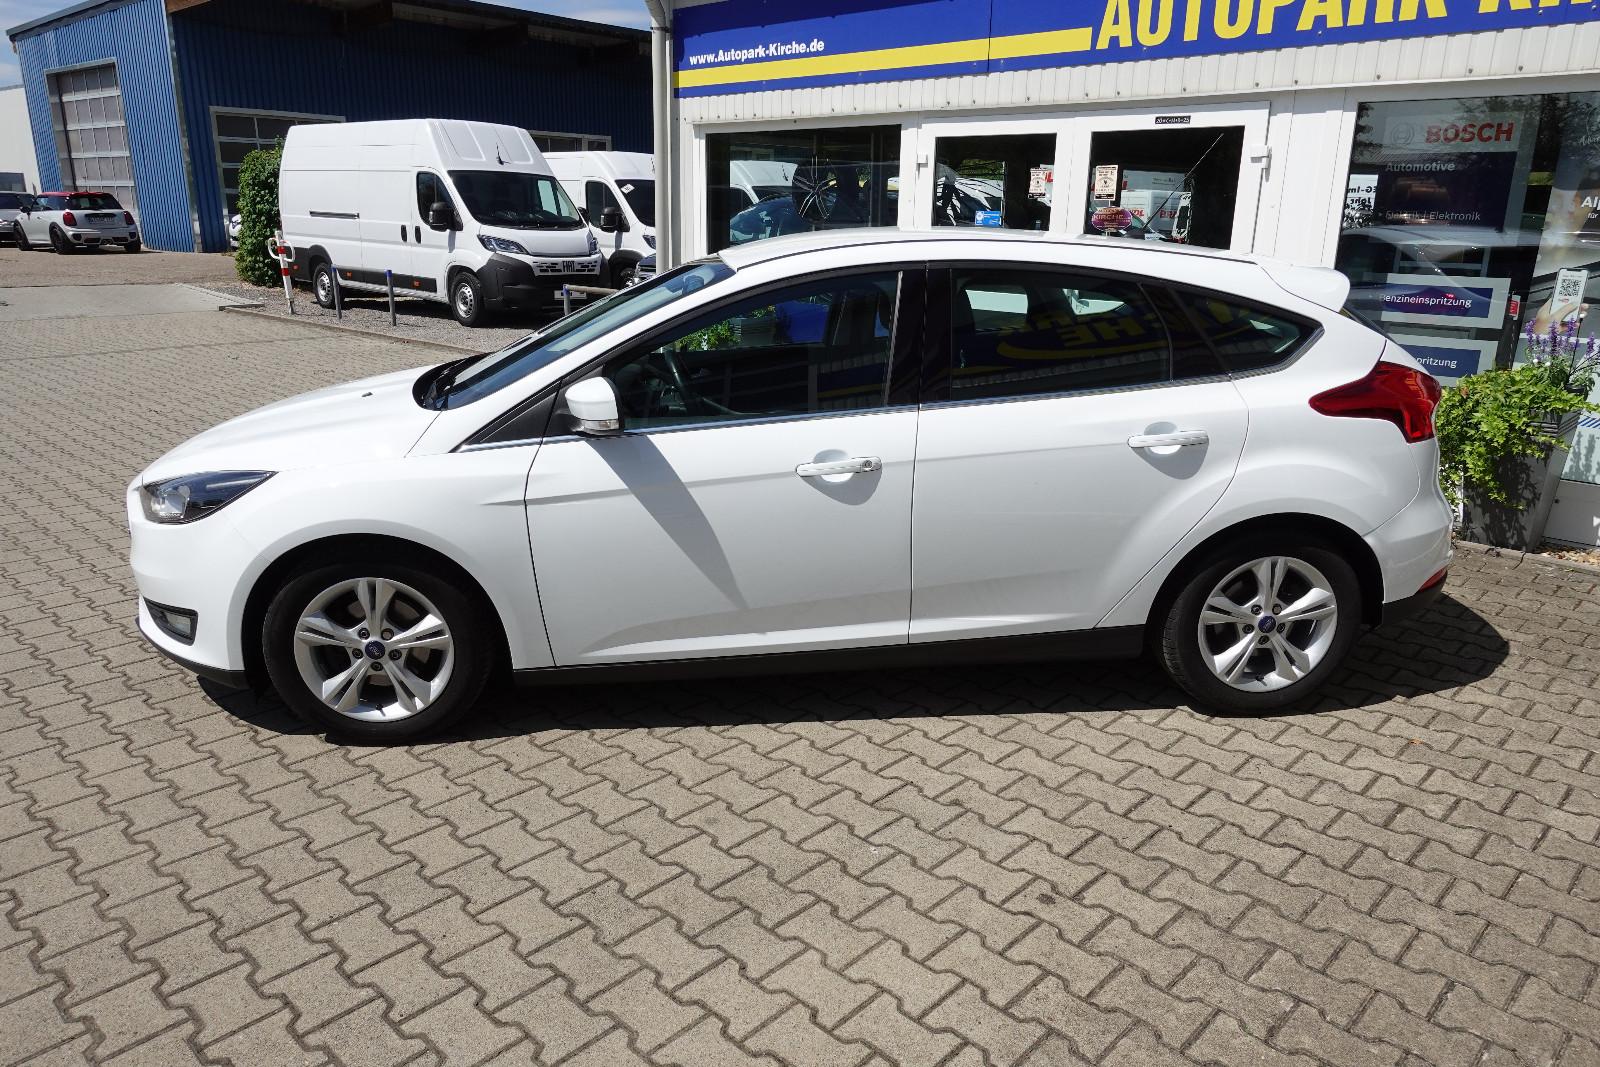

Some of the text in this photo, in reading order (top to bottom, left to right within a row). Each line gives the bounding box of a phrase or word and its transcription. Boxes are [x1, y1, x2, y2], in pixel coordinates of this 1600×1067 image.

[689, 38, 825, 65] www.Autopark-Kirche.de
[1425, 122, 1515, 144] BOSCH
[1385, 160, 1456, 172] Automotive
[1430, 211, 1481, 221] Elektronik
[562, 261, 575, 272] FIAT
[1379, 293, 1473, 308] Benzineinspritzung
[1416, 356, 1458, 369] pritzung
